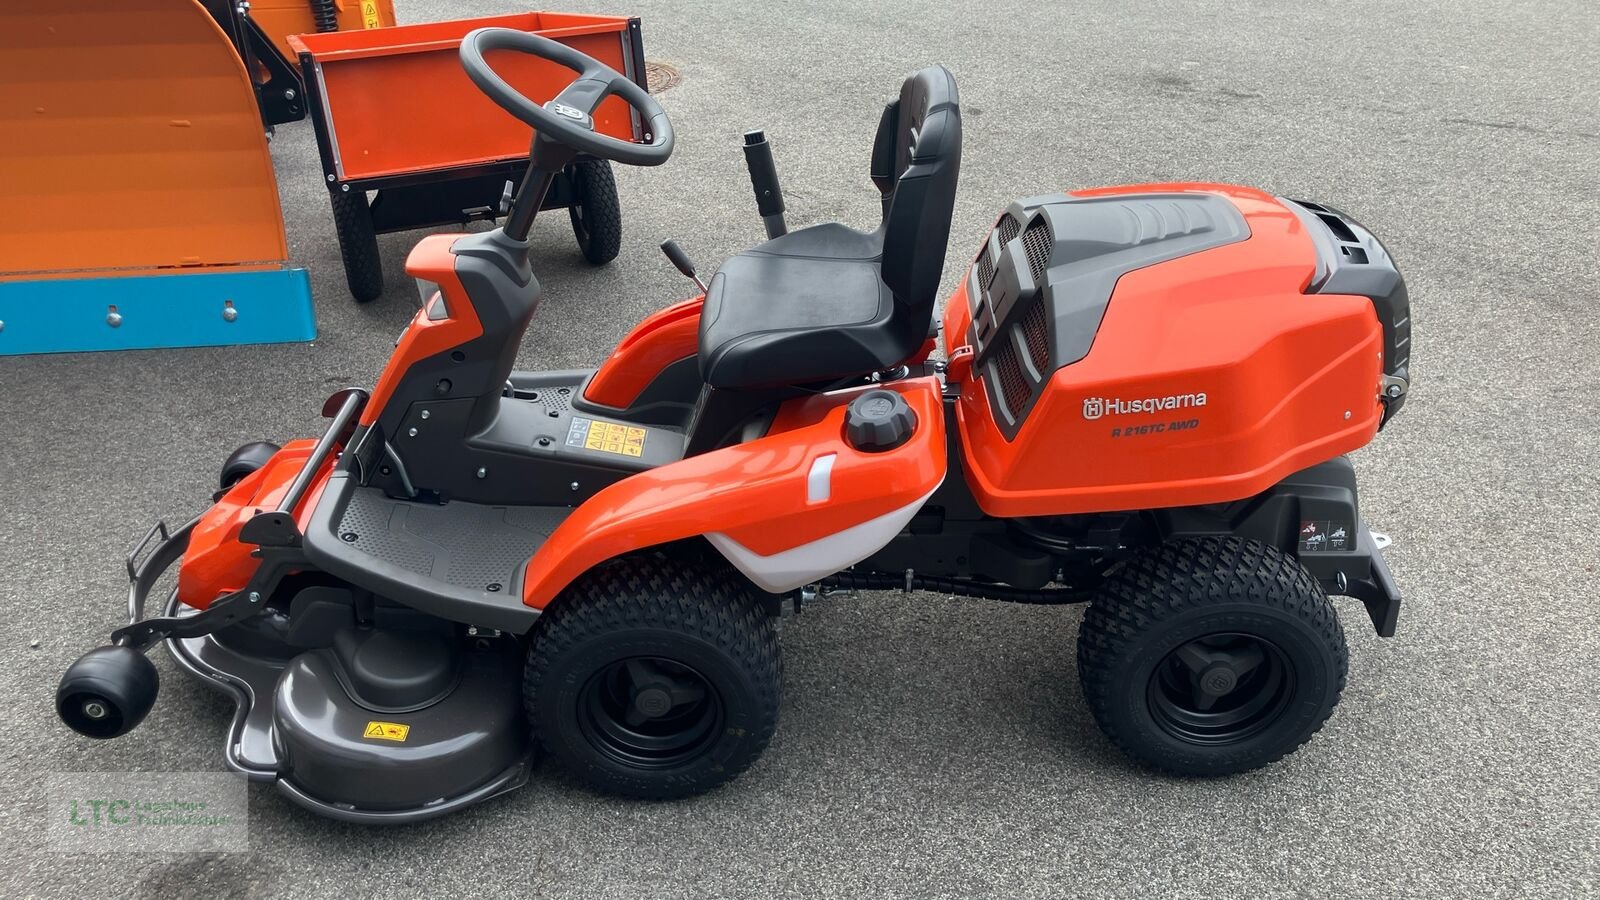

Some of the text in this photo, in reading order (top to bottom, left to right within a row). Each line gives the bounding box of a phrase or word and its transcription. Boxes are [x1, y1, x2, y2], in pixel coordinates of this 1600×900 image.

[1105, 392, 1207, 415] Husqvarna
[1111, 428, 1121, 438] R
[1168, 418, 1199, 431] AWD
